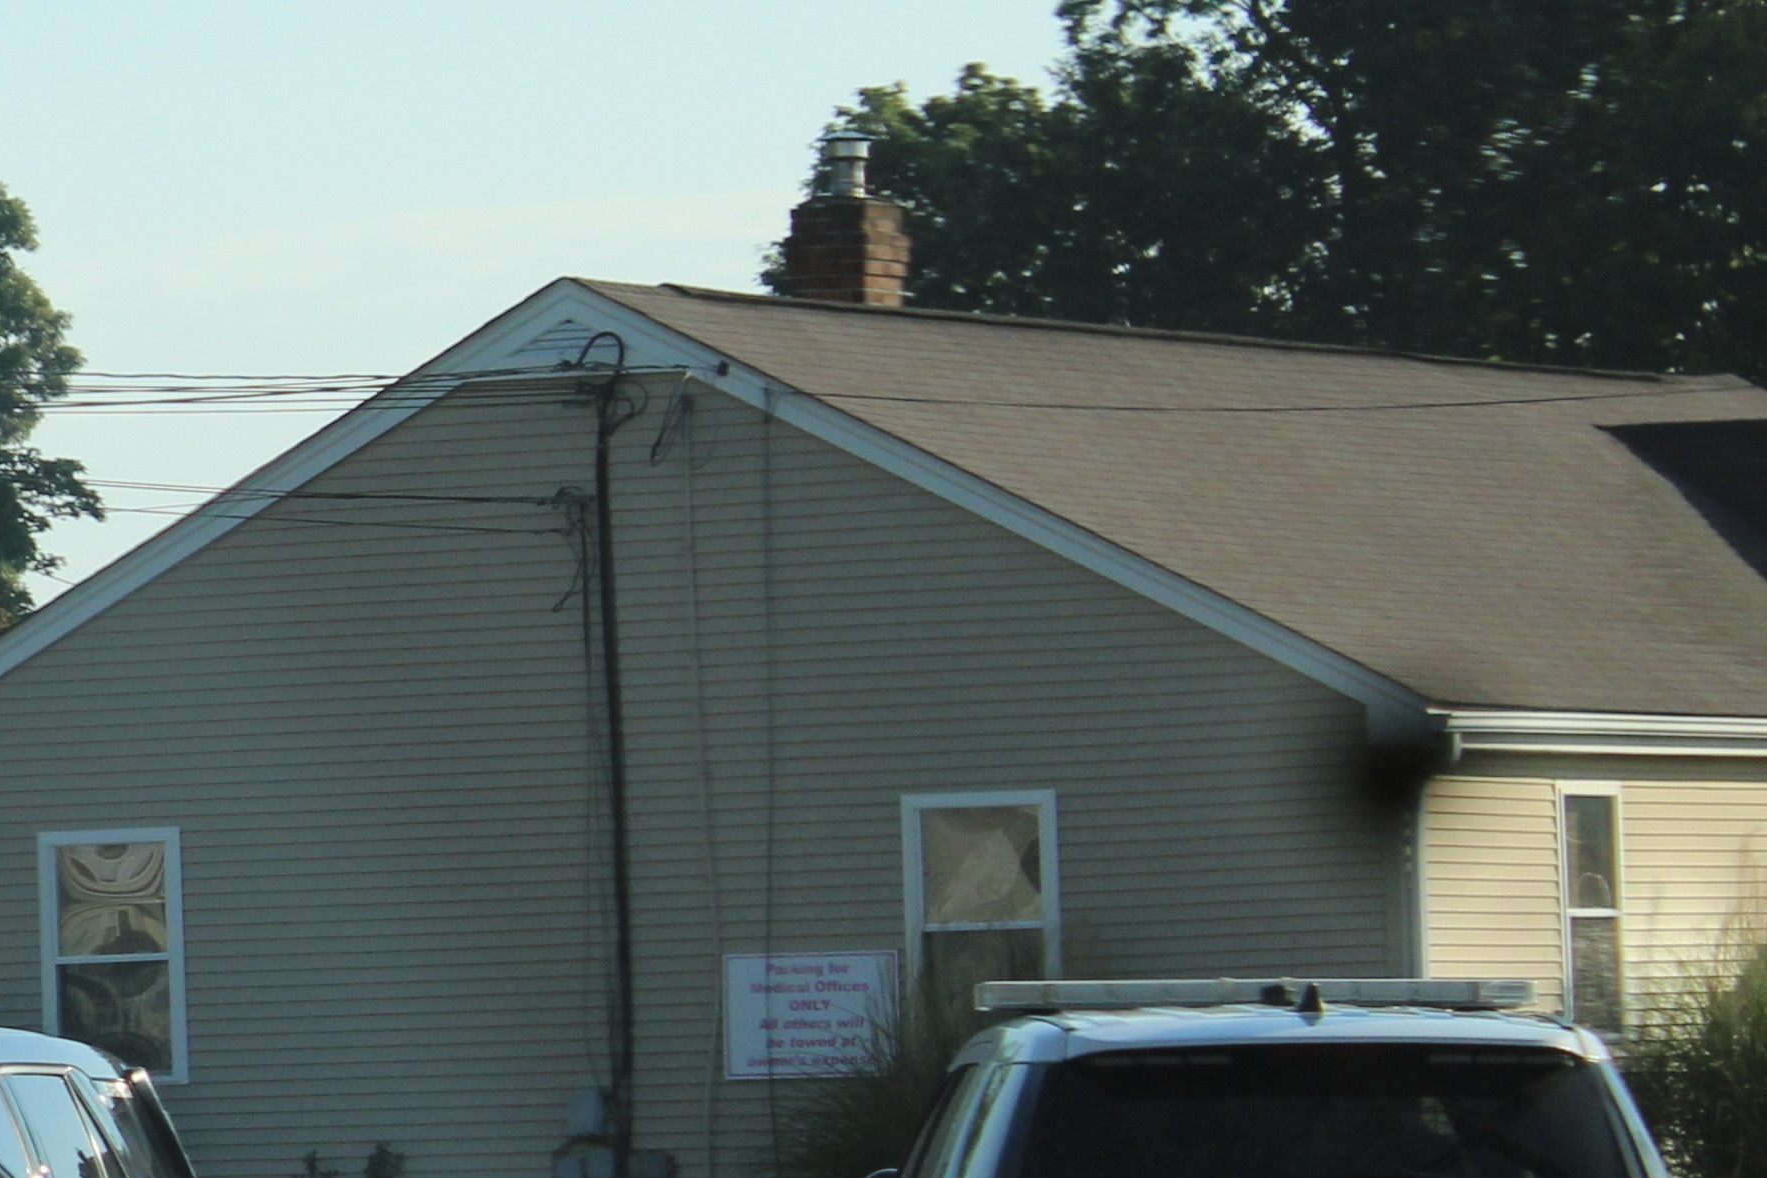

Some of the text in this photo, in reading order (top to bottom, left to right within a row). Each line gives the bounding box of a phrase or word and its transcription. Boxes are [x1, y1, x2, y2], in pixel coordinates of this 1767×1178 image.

[766, 962, 849, 977] Parking for
[750, 980, 869, 994] Medical Offices
[789, 999, 831, 1011] ONLY
[760, 1015, 864, 1030] All others will
[767, 1036, 857, 1048] be towed at
